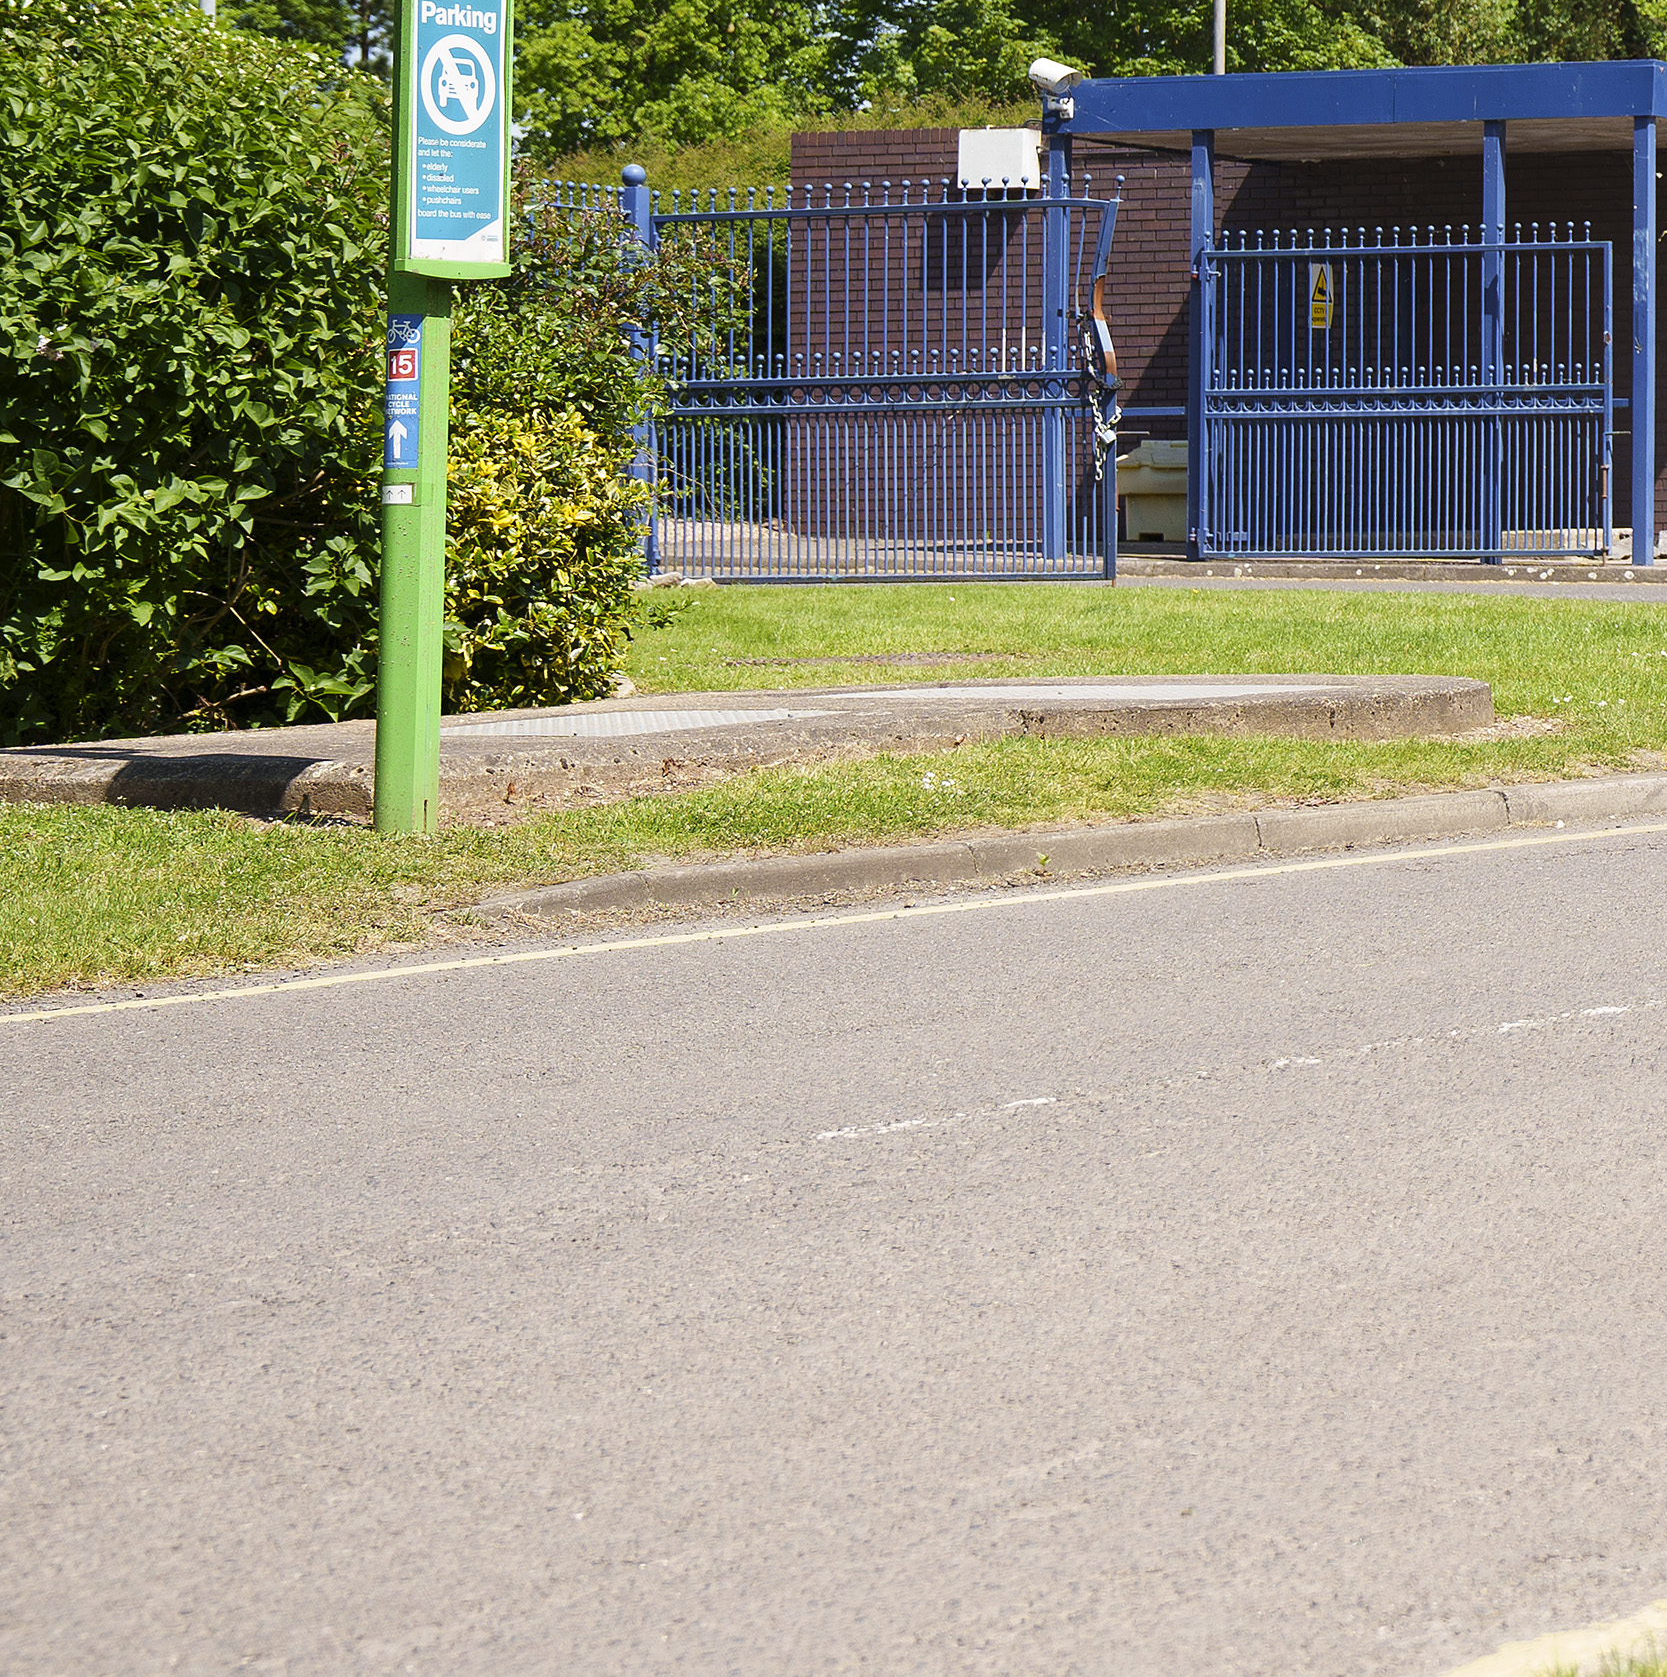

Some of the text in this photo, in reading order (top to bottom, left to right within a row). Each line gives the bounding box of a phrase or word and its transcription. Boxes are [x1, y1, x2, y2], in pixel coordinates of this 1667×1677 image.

[421, 0, 497, 35] Parking
[418, 136, 487, 149] Please be considerate
[418, 149, 430, 157] and
[431, 149, 440, 157] let
[462, 187, 480, 195] users
[426, 196, 462, 205] pushchairs
[418, 209, 437, 217] board
[438, 209, 449, 218] the
[449, 210, 462, 218] bus
[462, 210, 475, 219] with
[390, 355, 413, 375] 15
